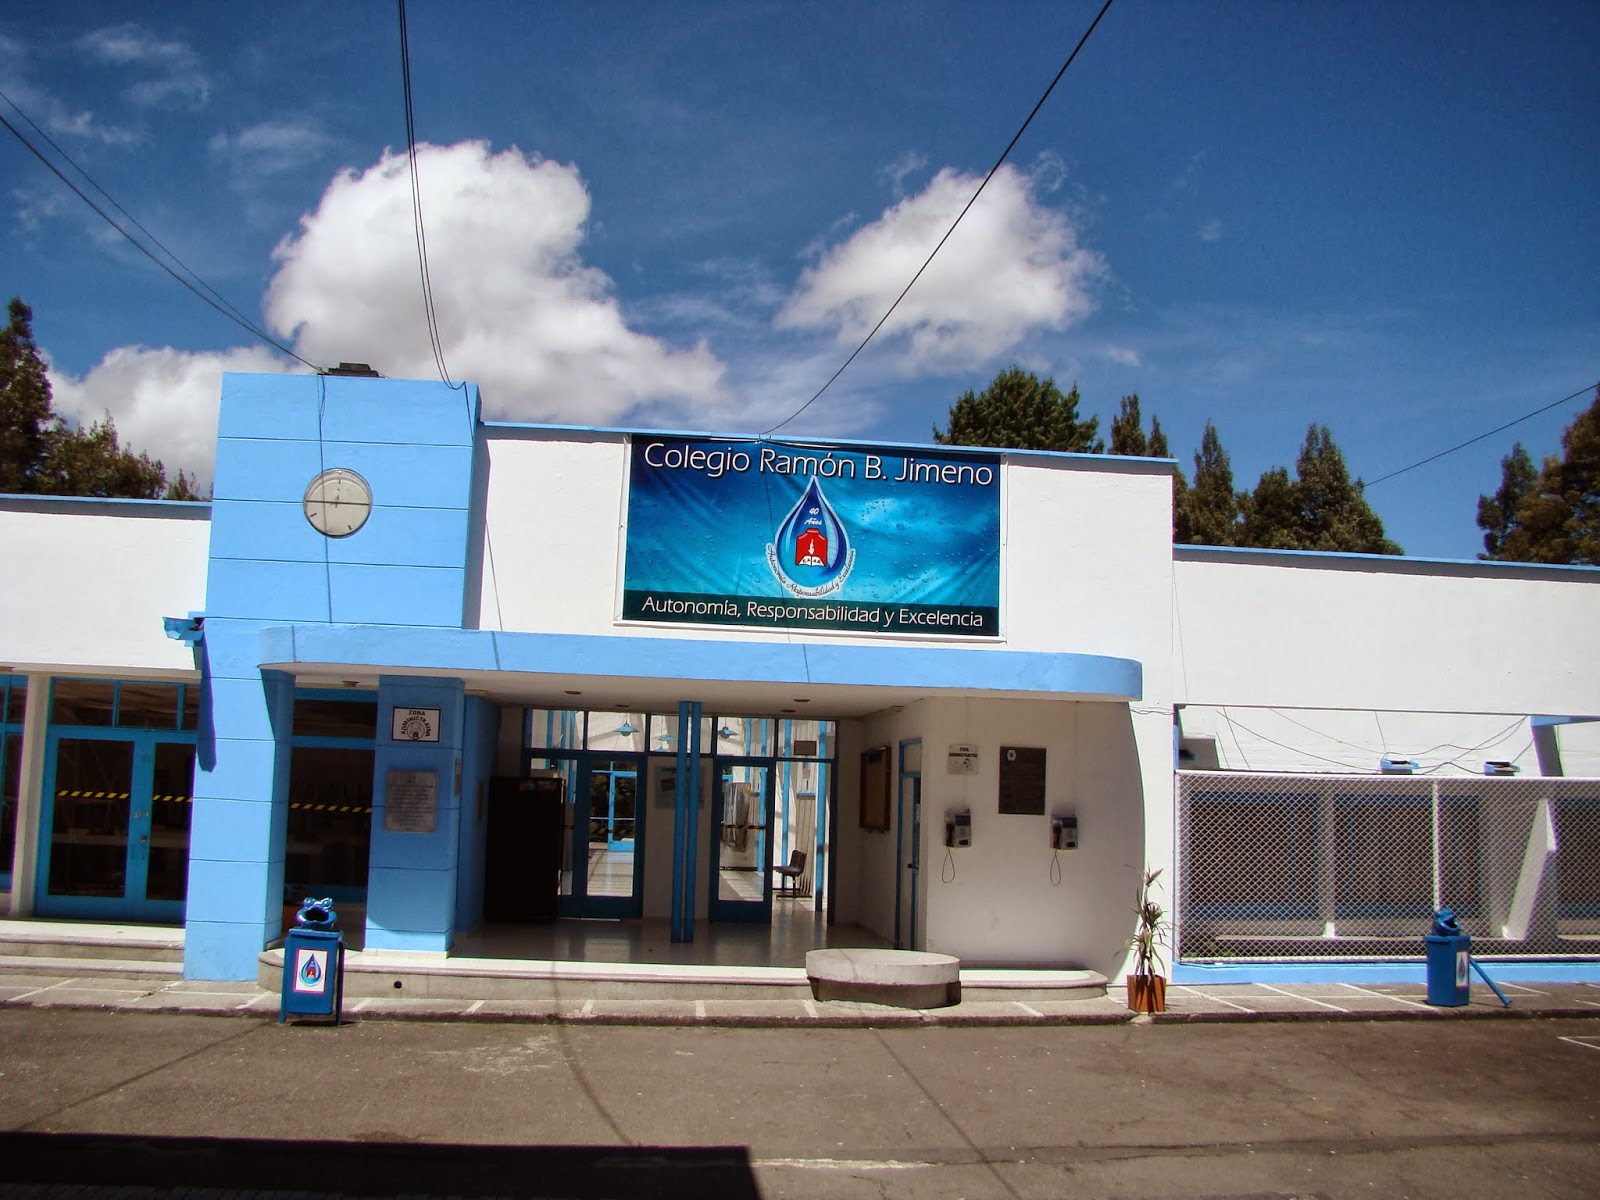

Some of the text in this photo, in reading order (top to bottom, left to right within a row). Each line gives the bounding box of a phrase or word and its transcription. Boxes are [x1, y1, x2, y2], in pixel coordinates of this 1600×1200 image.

[644, 442, 993, 486] Colegio Ramón B. Jimeno
[641, 596, 984, 628] Autonomía, Responsabilidad y Excelencia
